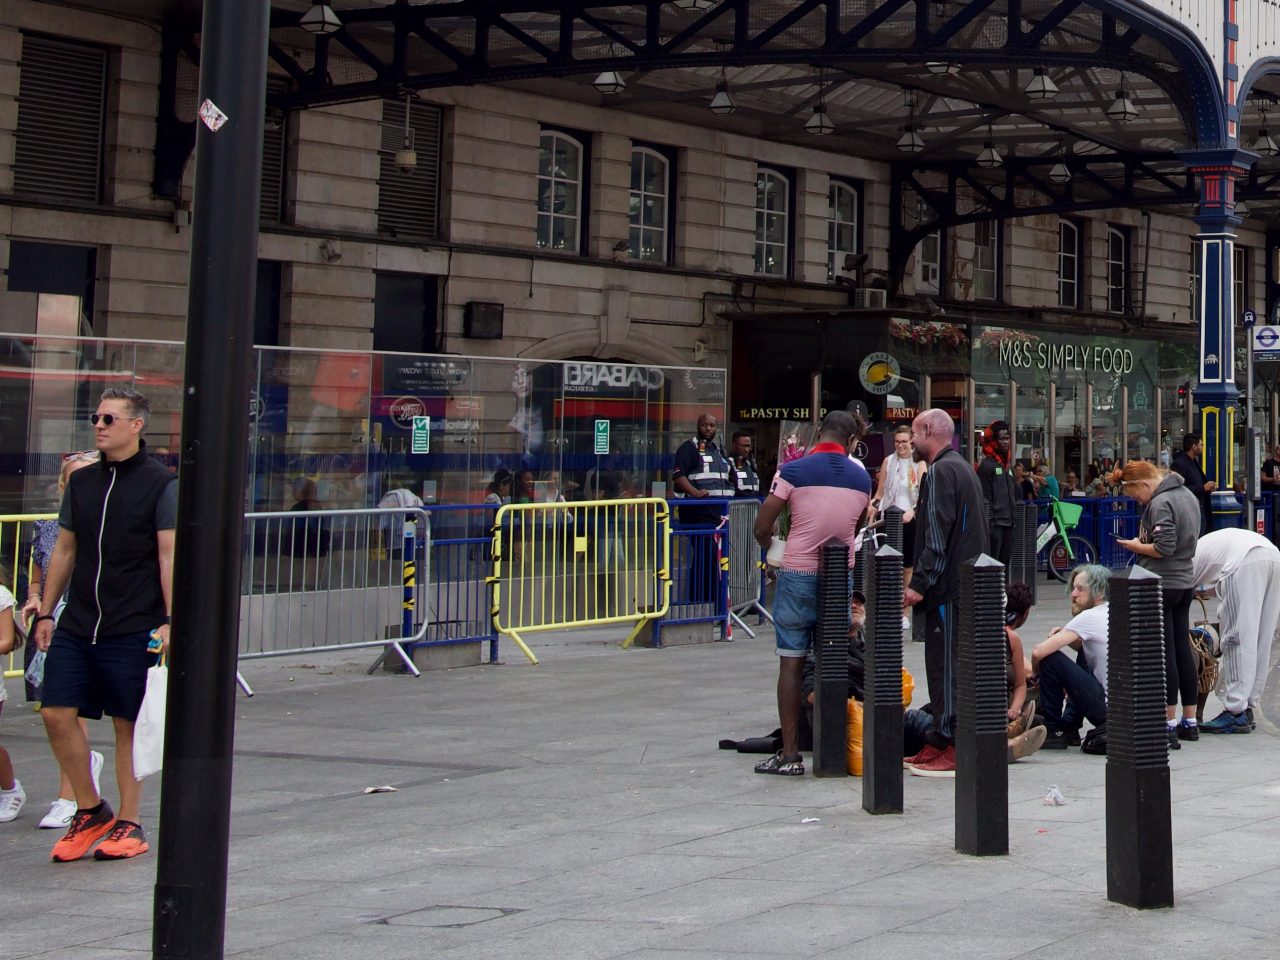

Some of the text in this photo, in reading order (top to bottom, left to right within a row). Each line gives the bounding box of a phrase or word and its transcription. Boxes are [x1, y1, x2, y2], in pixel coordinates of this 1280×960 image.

[999, 340, 1133, 374] M&S SIMPLY FOOD
[739, 407, 828, 419] The PASTY SHP
[892, 407, 915, 419] PASTY
